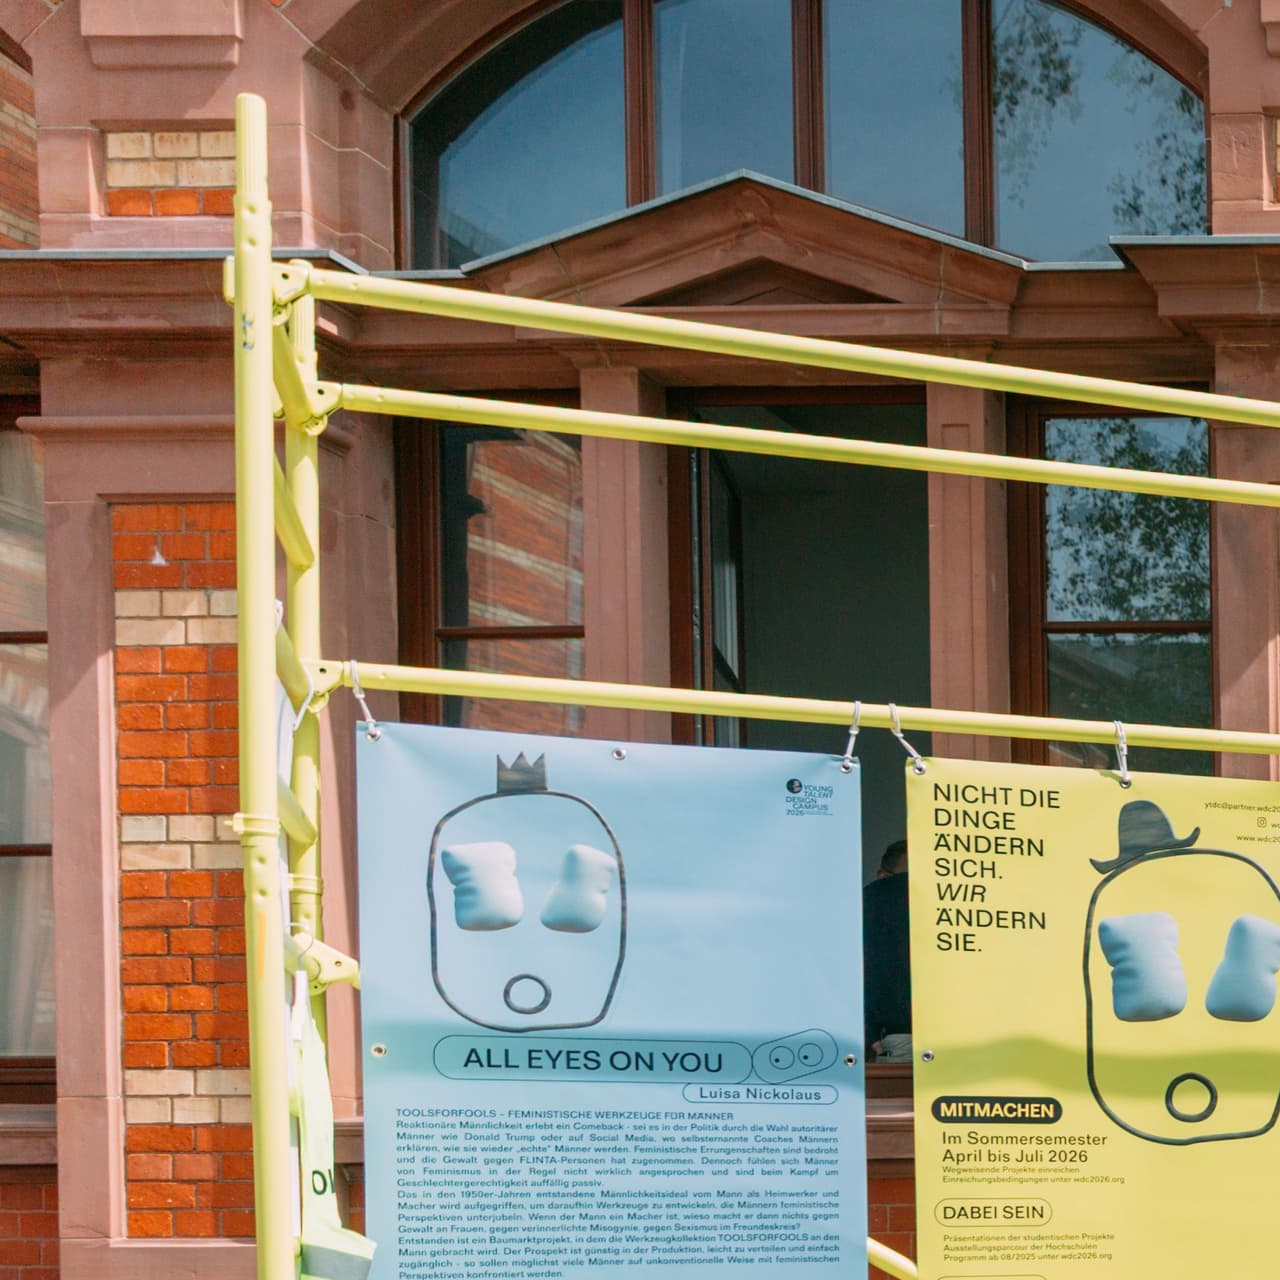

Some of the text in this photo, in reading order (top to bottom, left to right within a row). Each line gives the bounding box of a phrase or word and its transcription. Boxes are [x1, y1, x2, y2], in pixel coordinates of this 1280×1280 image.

[934, 783, 1061, 809] NICHT DIE
[934, 807, 1016, 831] DINGE
[933, 833, 1044, 857] ÄNDERN
[935, 857, 1003, 880] SICH.
[936, 882, 987, 903] WIR
[935, 907, 1046, 930] ÄNDERN
[936, 932, 982, 952] SIE.
[463, 1047, 723, 1073] ALL EYES ON YOU
[699, 1087, 822, 1101] Luisa Nickolaus
[940, 1102, 1054, 1118] MITMACHEN
[942, 1130, 1108, 1146] Im Sommersemester
[942, 1148, 1088, 1166] April bis Juli 2026
[943, 1205, 1044, 1220] DABEI SEIN
